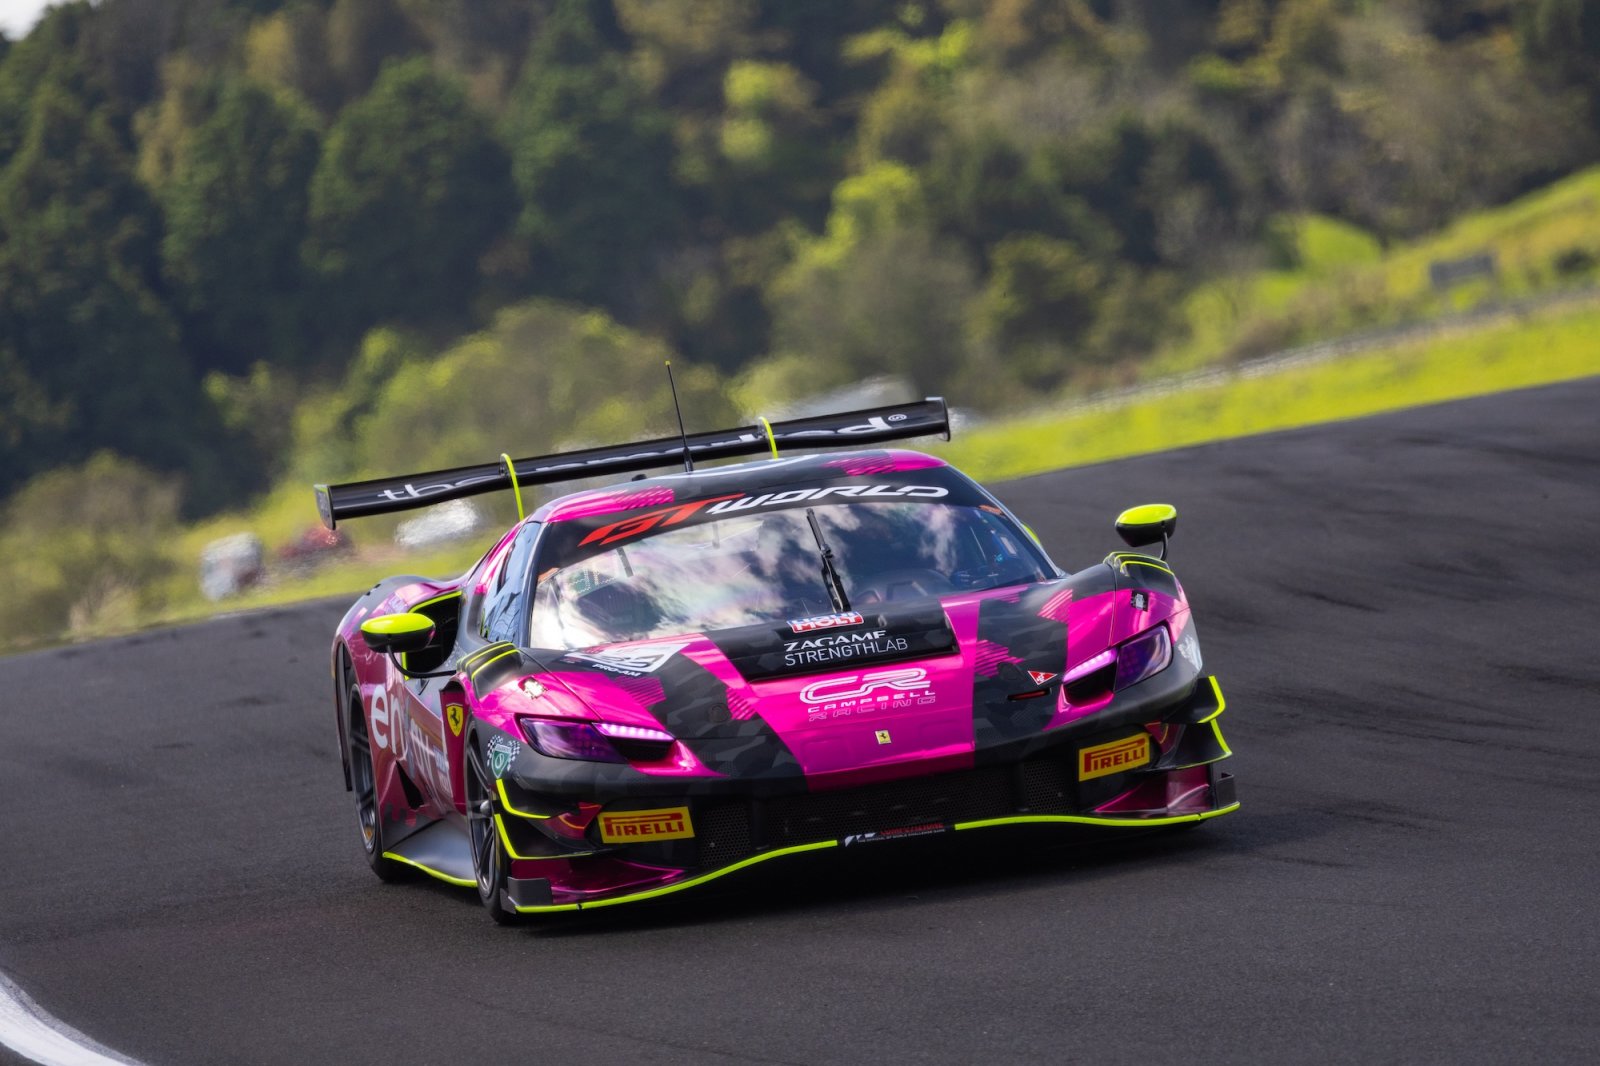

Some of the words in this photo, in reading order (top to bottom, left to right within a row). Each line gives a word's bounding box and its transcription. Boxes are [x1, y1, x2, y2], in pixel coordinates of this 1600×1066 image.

[577, 493, 745, 547] GT
[706, 485, 949, 514] WORLD
[796, 616, 858, 631] MOLY
[784, 638, 909, 666] STRENGTHLAB
[592, 663, 642, 677] PRO-AM
[800, 668, 931, 704] CR
[808, 690, 936, 713] CAMPBELL
[809, 696, 936, 722] RACING
[1084, 738, 1146, 773] PIRELLI
[603, 812, 685, 837] PIRELLI
